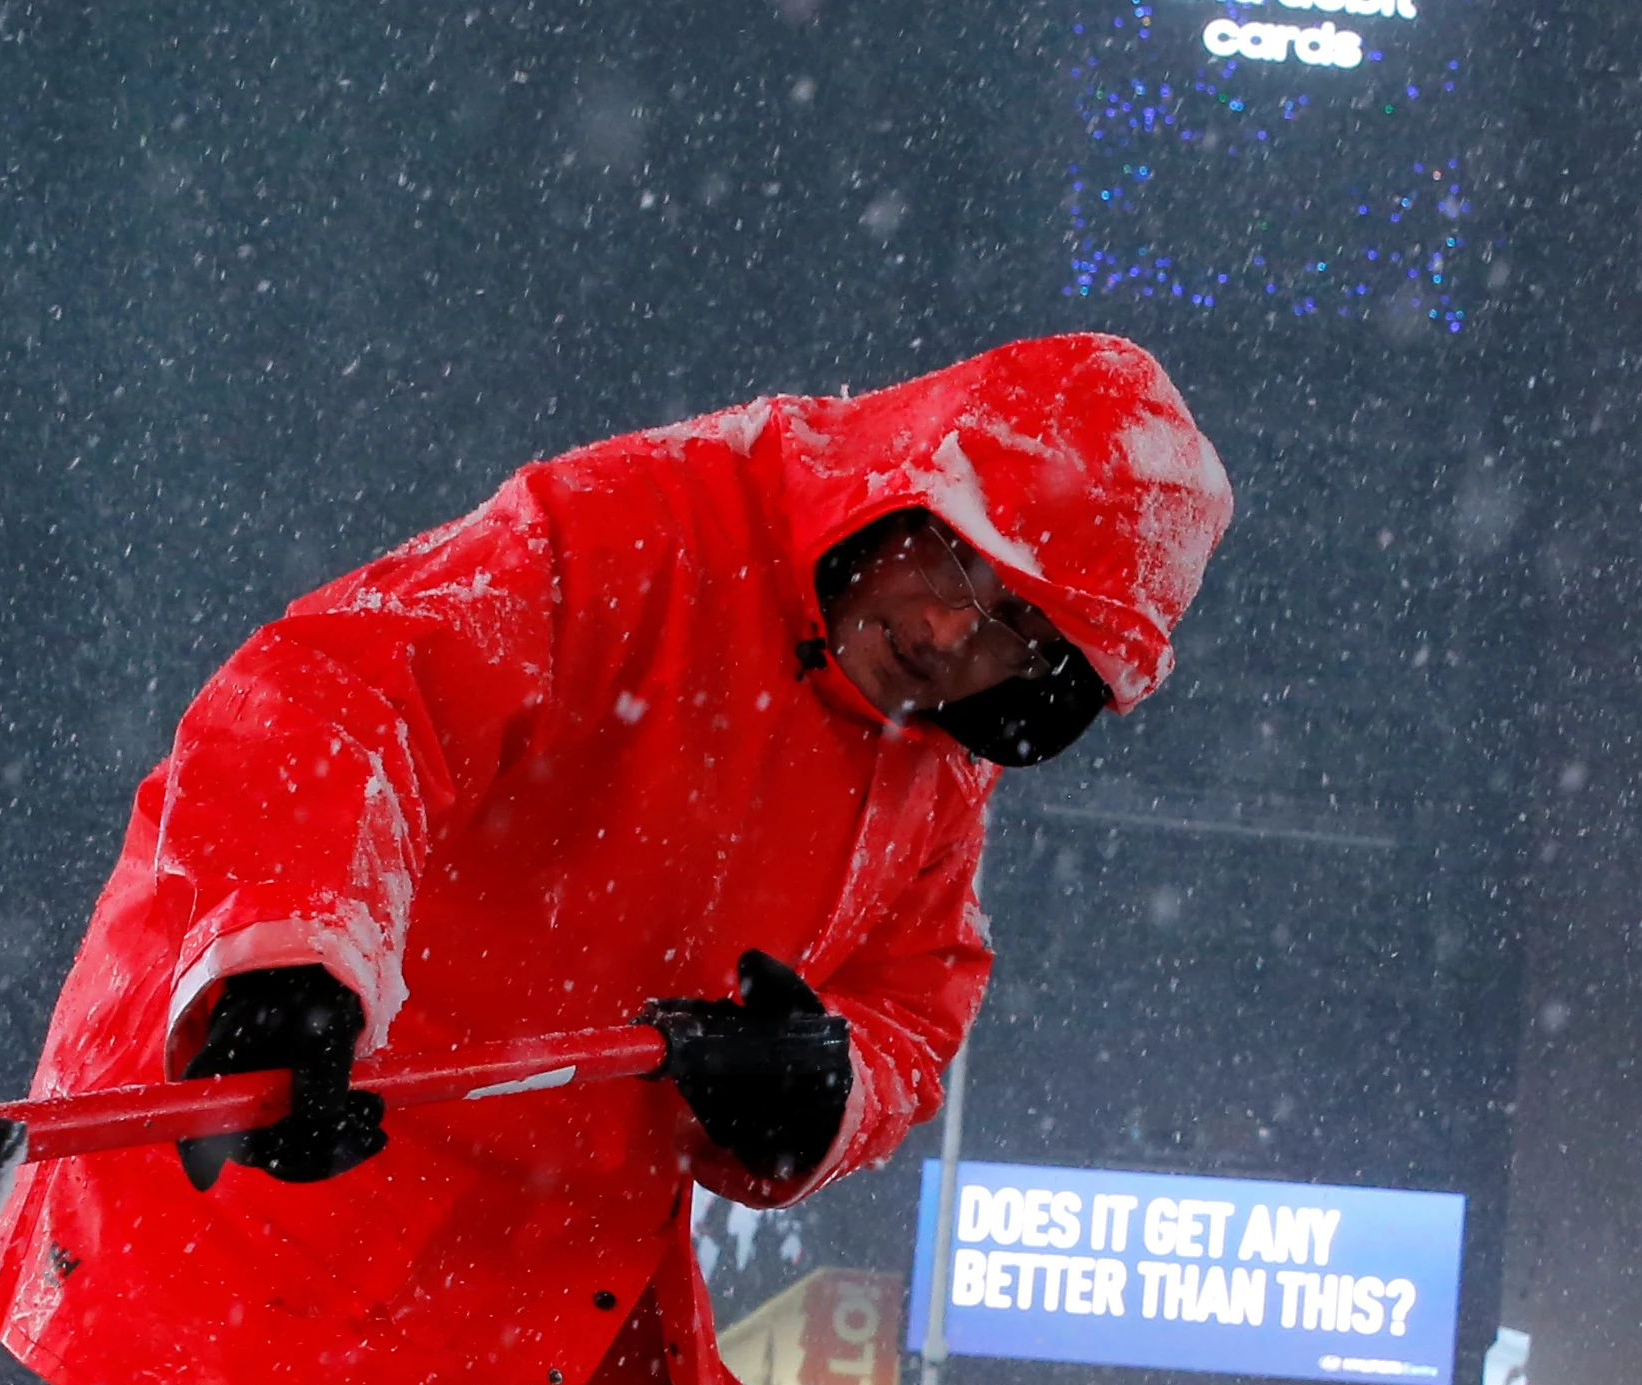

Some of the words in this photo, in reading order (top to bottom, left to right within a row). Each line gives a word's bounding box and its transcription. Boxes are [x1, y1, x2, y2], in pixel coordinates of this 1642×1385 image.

[1203, 18, 1363, 69] cards
[956, 1185, 1082, 1249] DOES
[1090, 1193, 1138, 1252] IT
[1143, 1197, 1236, 1259] GET
[1238, 1204, 1341, 1266] ANY
[951, 1248, 1128, 1317] BETTER
[1137, 1261, 1267, 1327] THAN
[1276, 1270, 1417, 1337] THIS?
